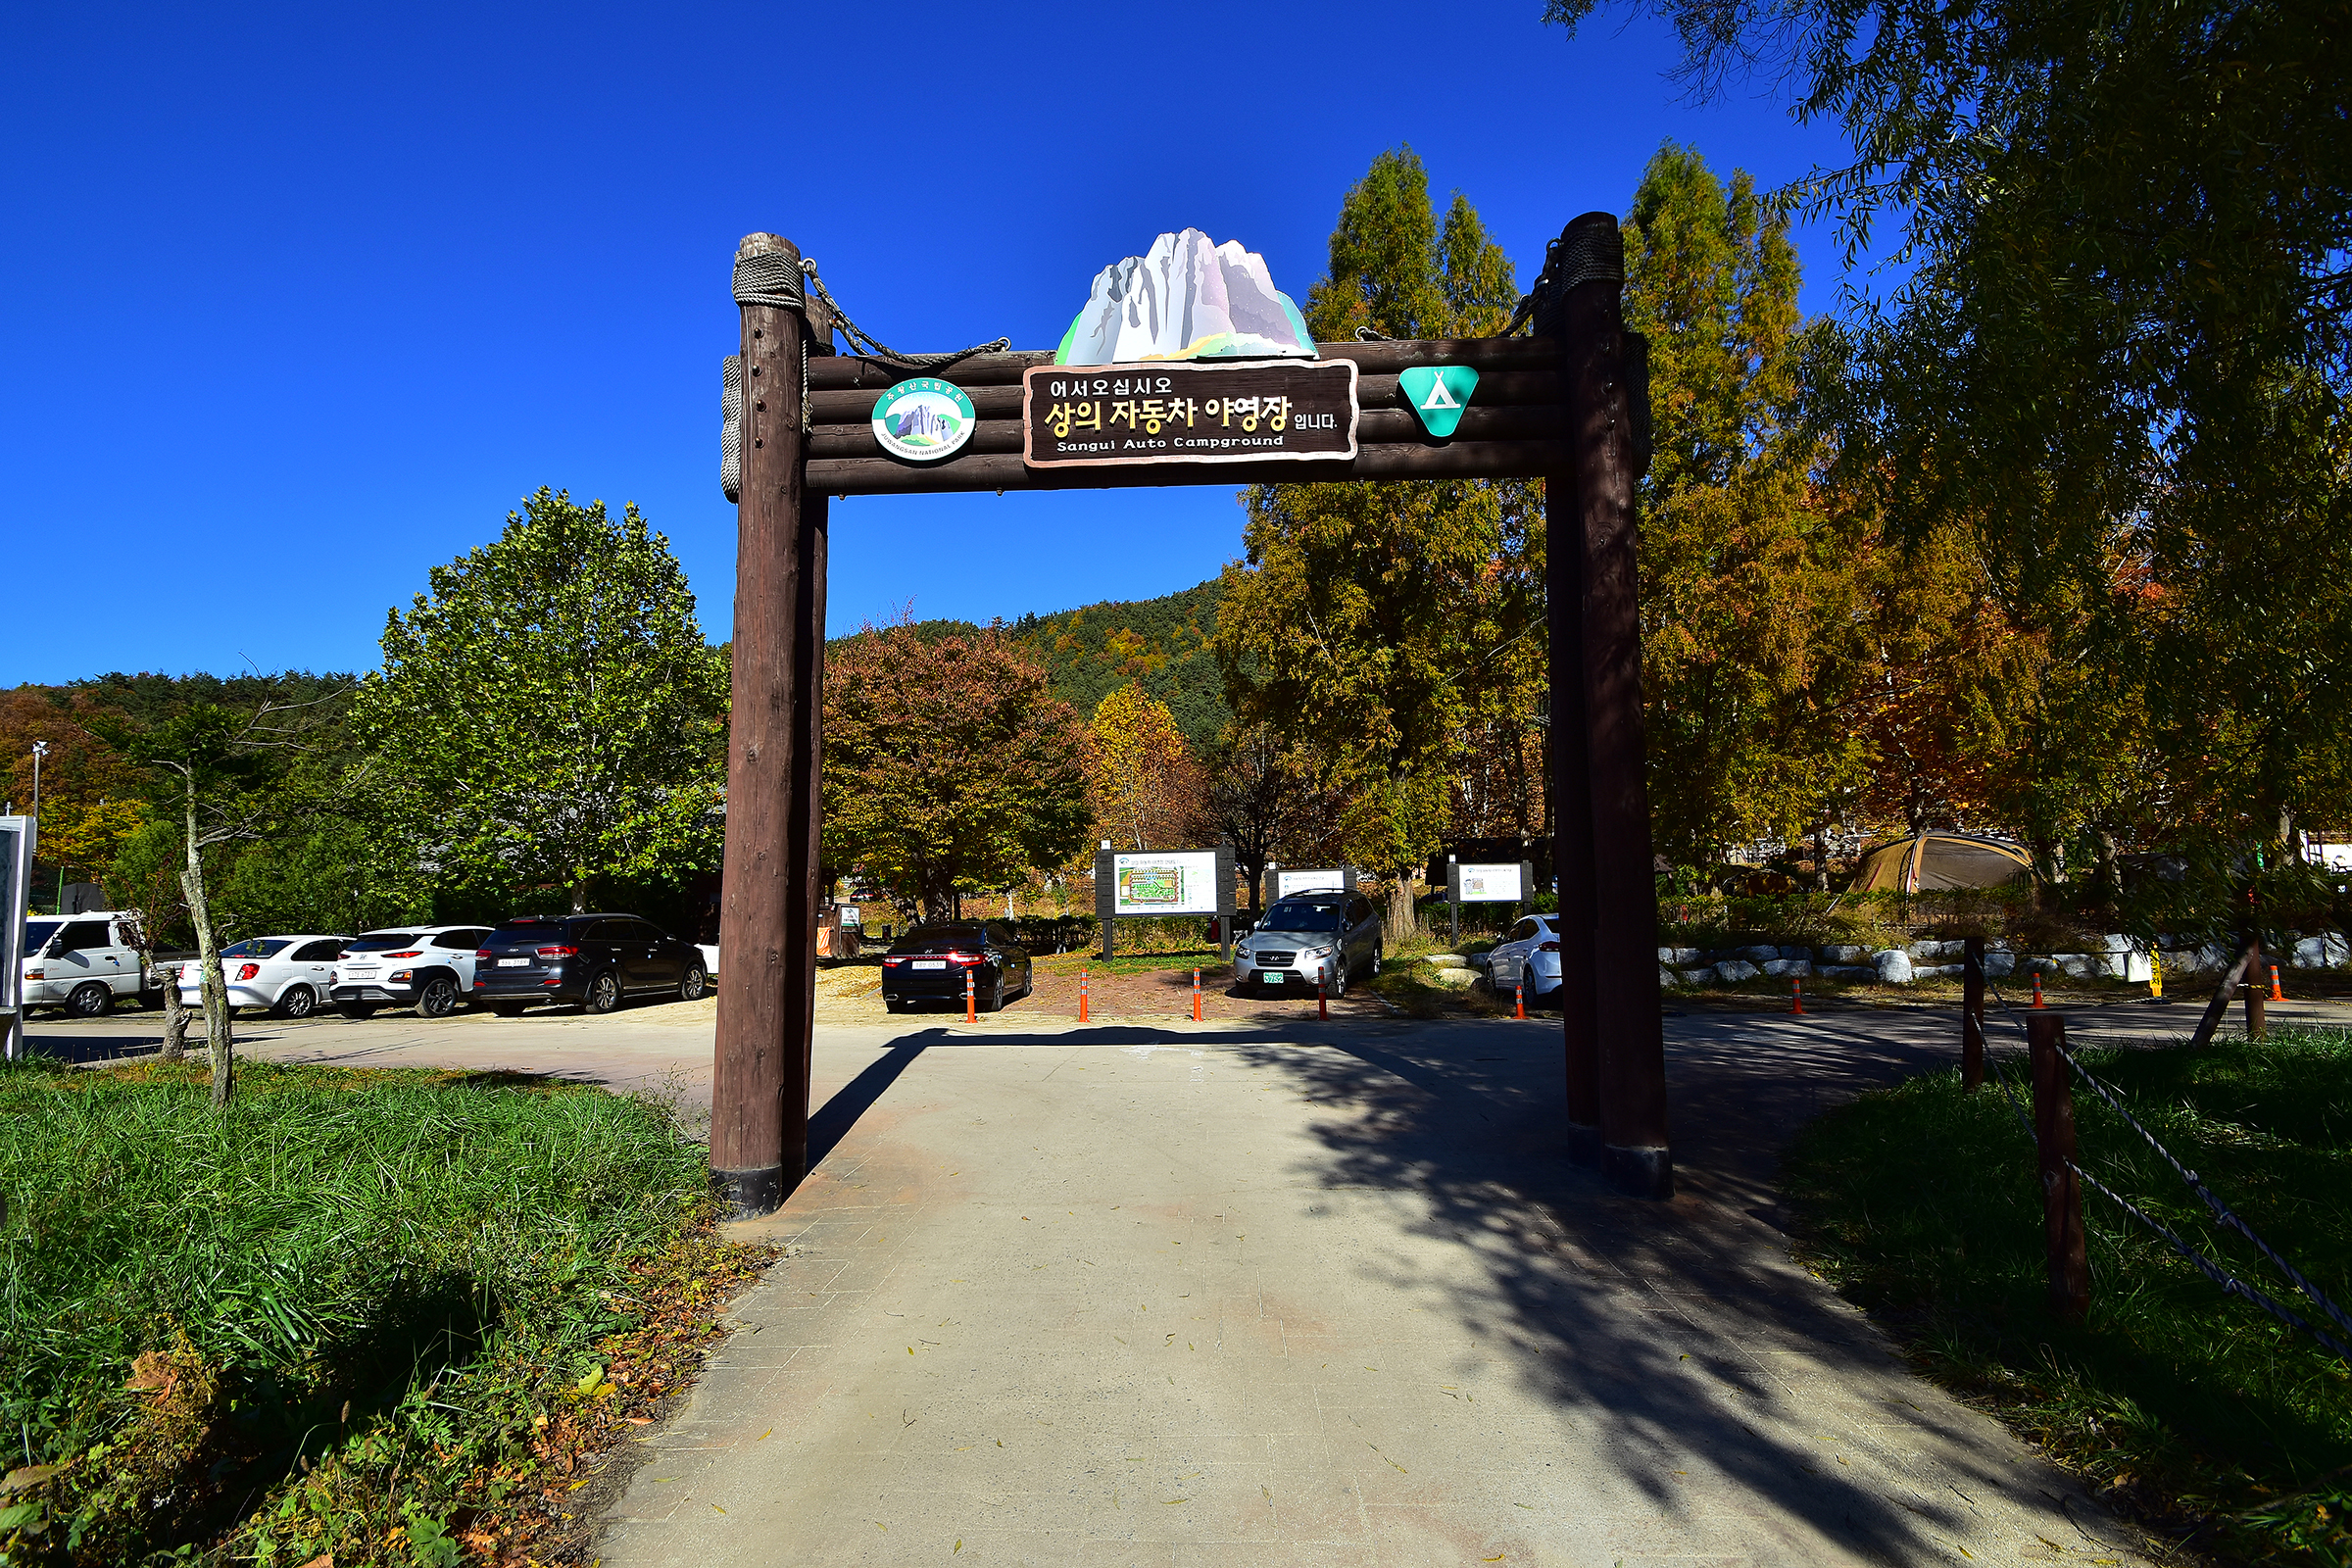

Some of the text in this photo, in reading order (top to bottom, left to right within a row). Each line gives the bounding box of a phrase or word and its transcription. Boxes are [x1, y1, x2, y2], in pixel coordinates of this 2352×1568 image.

[1051, 376, 1173, 397] 어서오십시오
[1045, 396, 1338, 438] 상의 자동차 야영장 입니다.
[1056, 435, 1284, 452] Sangui Auto Campground
